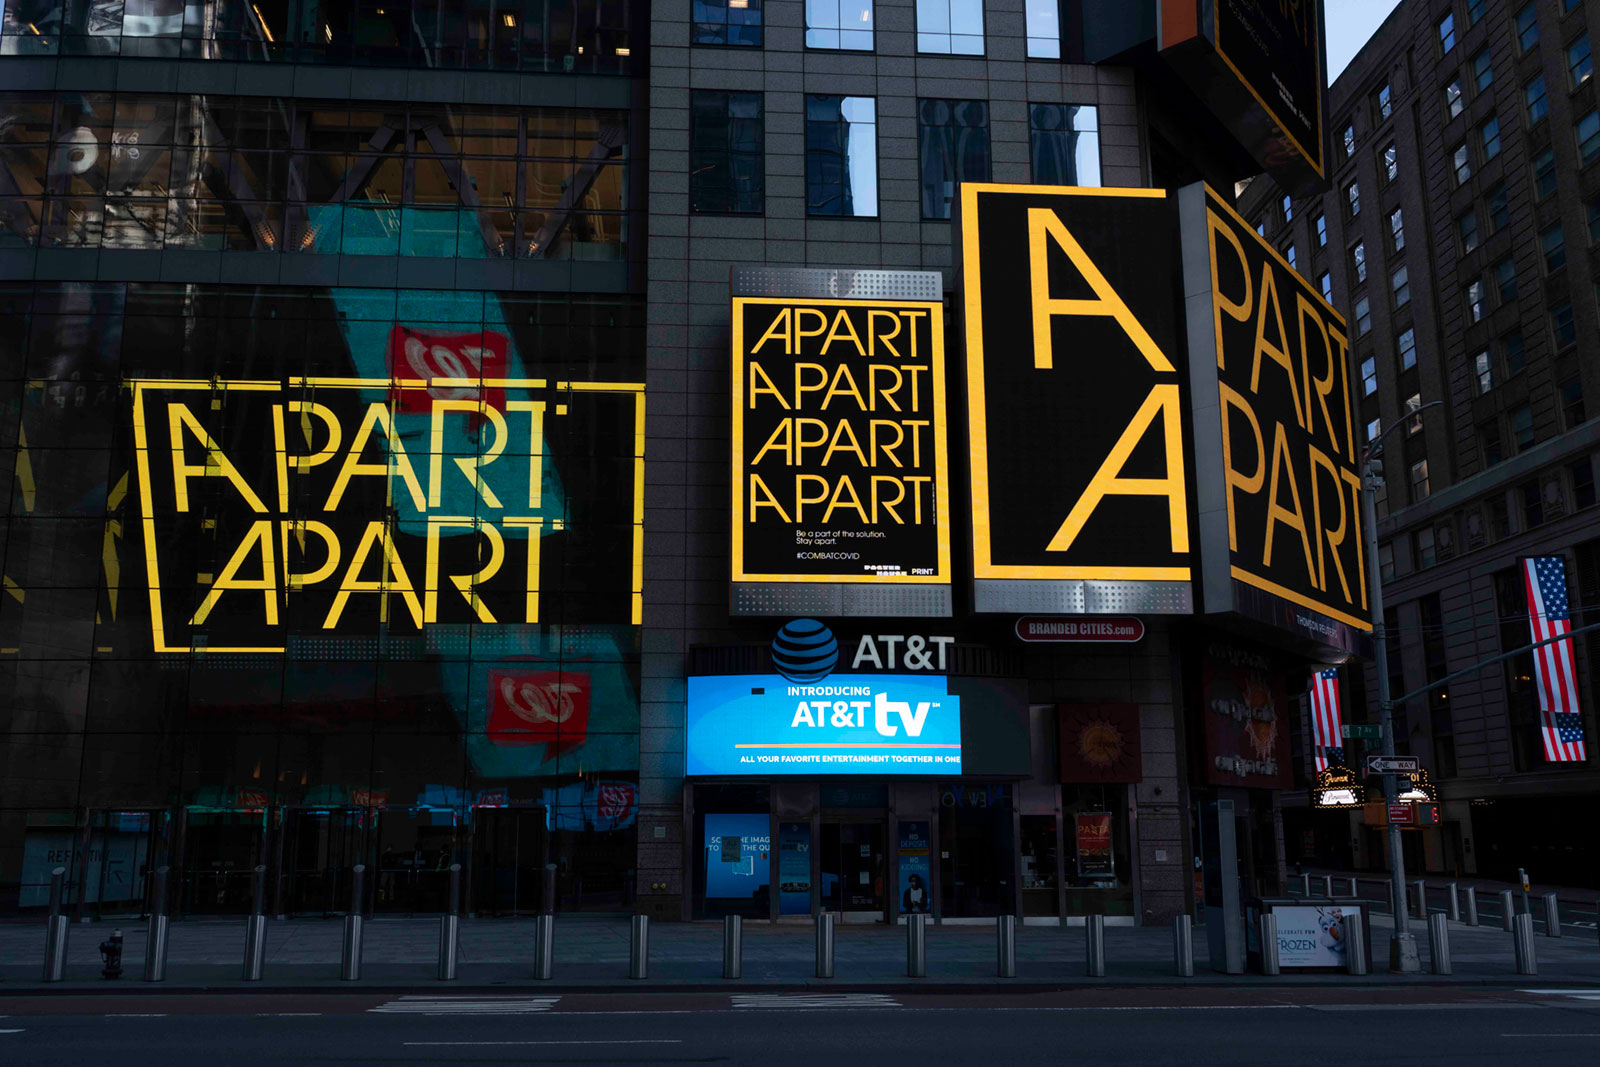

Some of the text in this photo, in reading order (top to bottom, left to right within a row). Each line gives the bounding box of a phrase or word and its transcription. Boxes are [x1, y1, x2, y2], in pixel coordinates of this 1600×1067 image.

[796, 530, 806, 538] Be
[815, 530, 831, 539] part
[832, 530, 841, 538] of
[842, 530, 855, 538] the
[856, 530, 886, 538] solution.
[796, 537, 813, 546] Stay
[796, 552, 860, 560] #COMBATCOVID
[1028, 622, 1135, 635] BRANDED CITIES.com
[851, 635, 955, 671] AT&T
[787, 686, 871, 696] INTRODUCING
[790, 701, 871, 728] AT&T
[874, 692, 931, 737] tv
[1357, 726, 1362, 737] 7
[740, 755, 961, 763] ALL YOUR FAVORITE ENTERTAINMENT TOGETHER IN ONE
[1374, 761, 1415, 769] ONE WAY
[750, 836, 771, 844] IMAG
[1277, 937, 1316, 953] FROZEN
